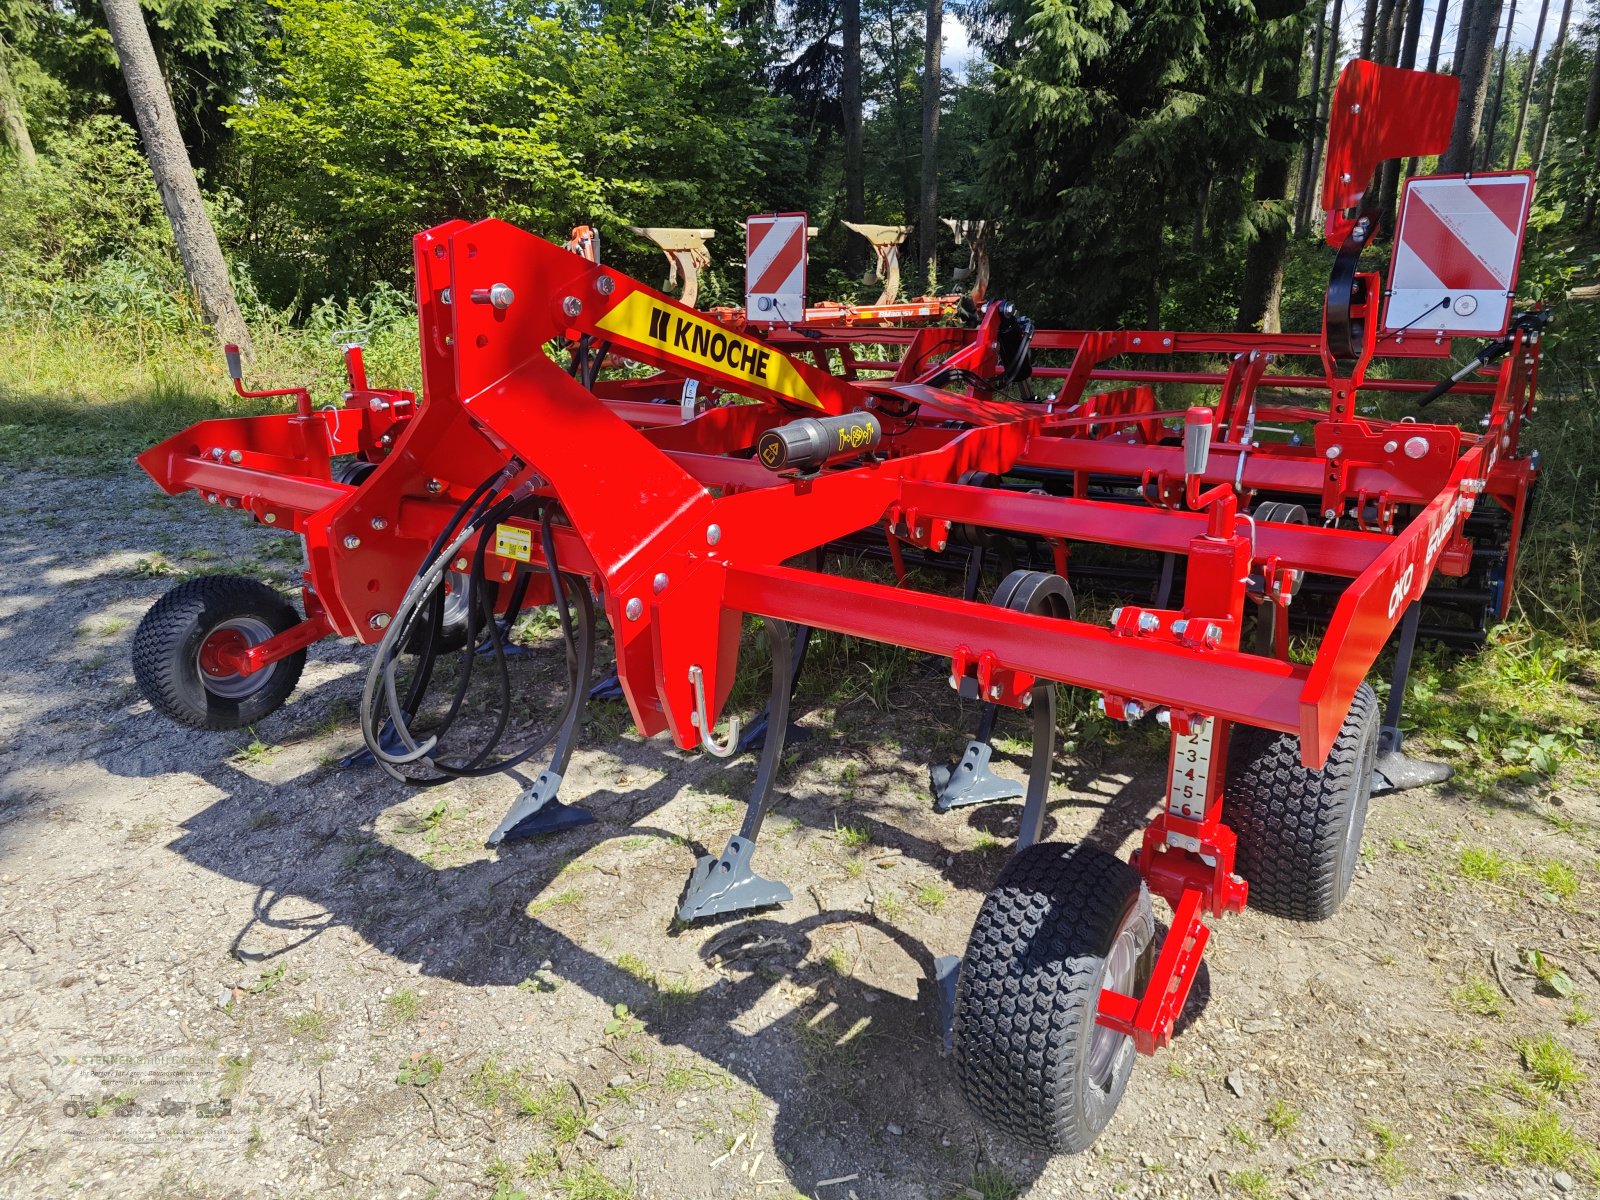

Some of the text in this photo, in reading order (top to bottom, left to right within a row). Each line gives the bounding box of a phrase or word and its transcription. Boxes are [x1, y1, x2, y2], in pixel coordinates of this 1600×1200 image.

[673, 317, 770, 380] KNOCHE
[1188, 733, 1199, 745] 2
[1187, 750, 1197, 763] 3
[1185, 768, 1195, 781] 4
[1183, 785, 1194, 799] 5
[1181, 803, 1192, 816] 6
